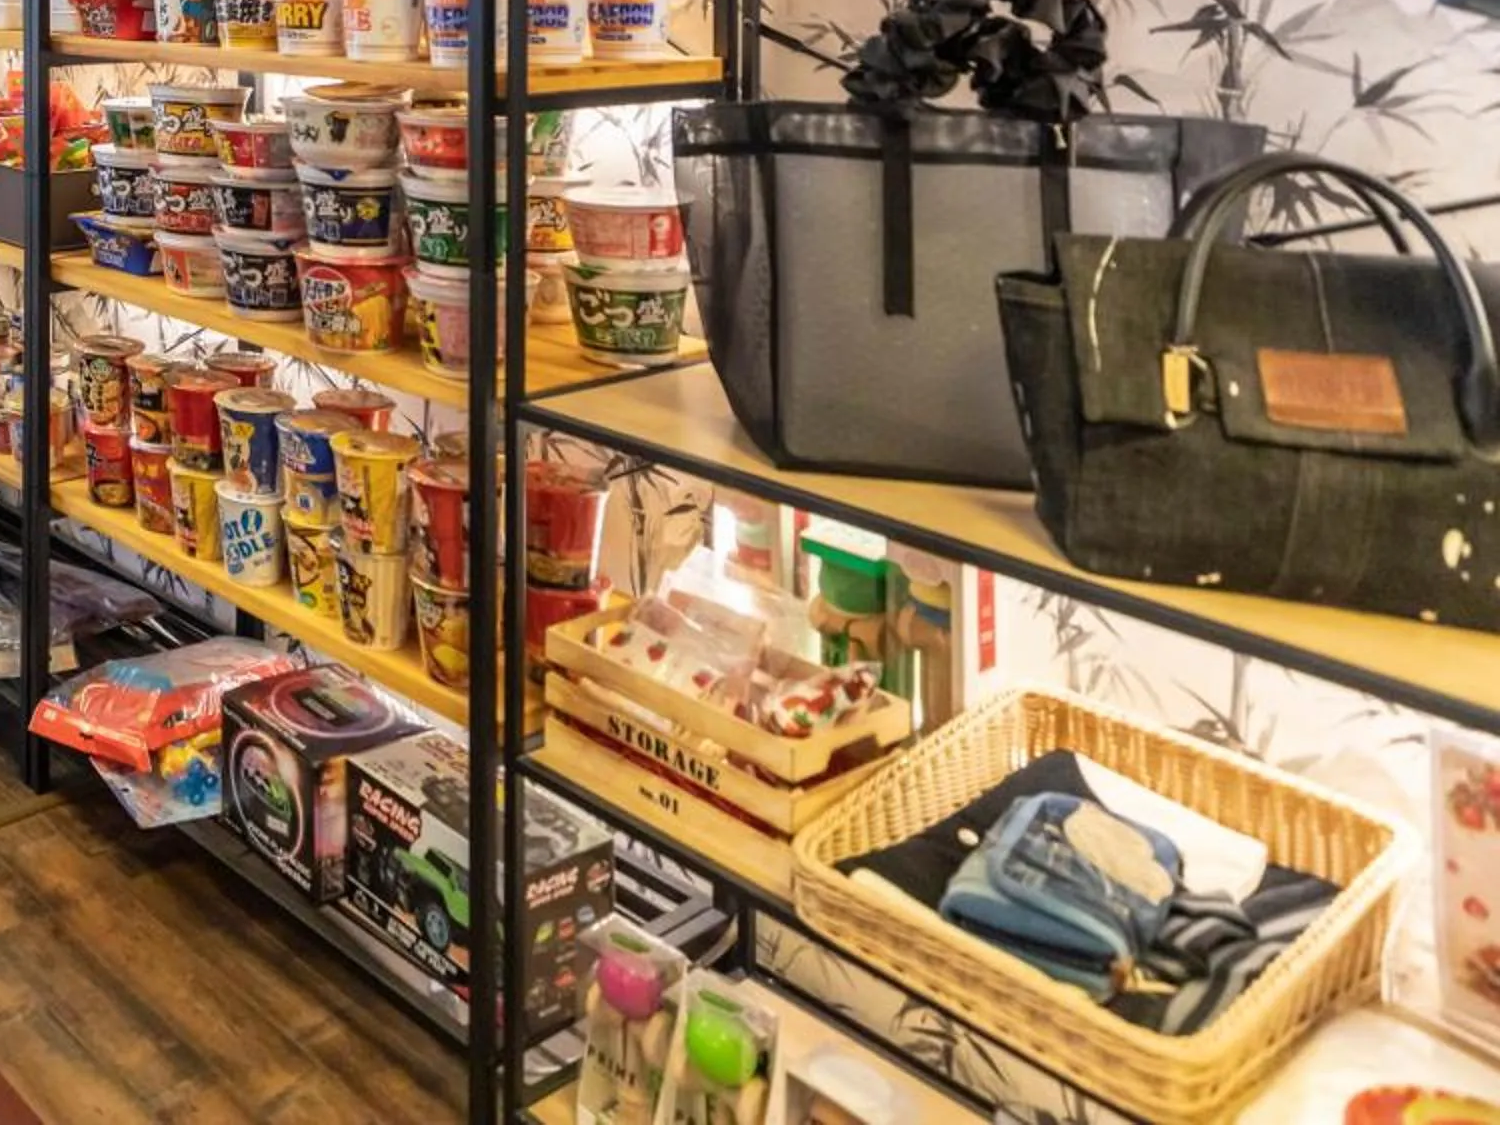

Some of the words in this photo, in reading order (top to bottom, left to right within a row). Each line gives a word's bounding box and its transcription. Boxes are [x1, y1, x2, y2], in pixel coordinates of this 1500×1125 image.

[276, 1, 329, 30] RRY
[605, 713, 722, 792] STORAGE
[359, 779, 422, 835] RACING
